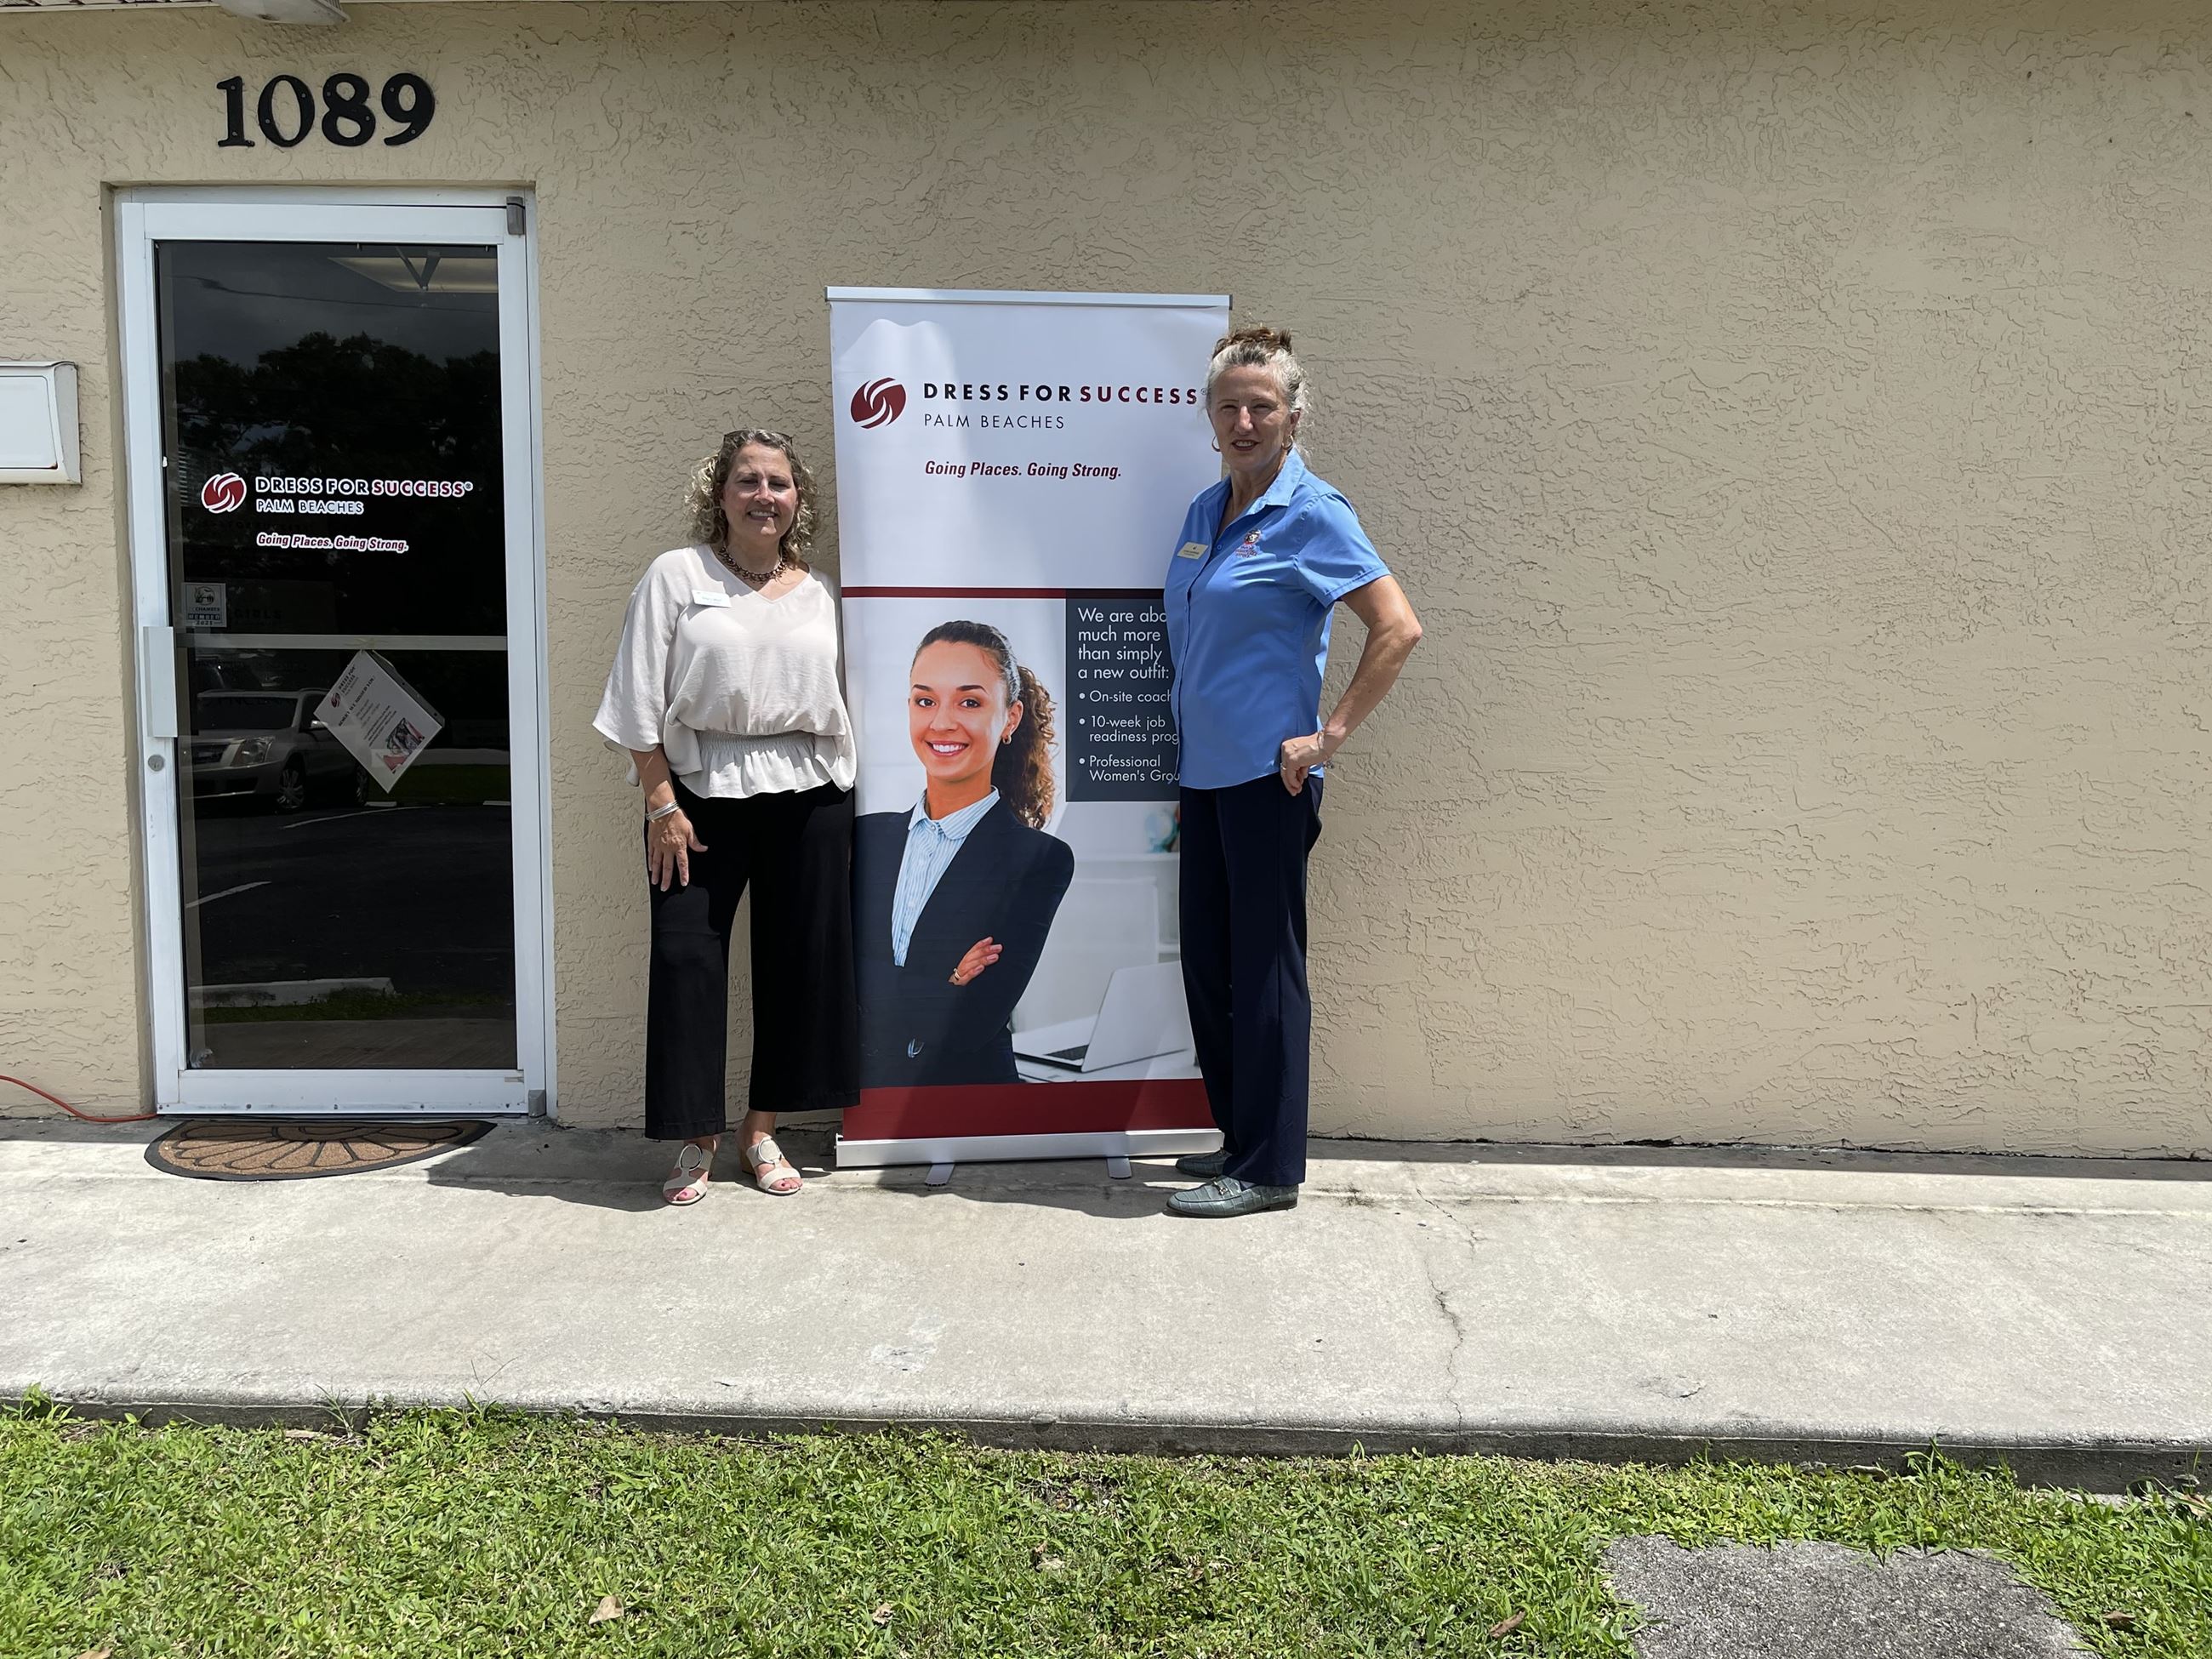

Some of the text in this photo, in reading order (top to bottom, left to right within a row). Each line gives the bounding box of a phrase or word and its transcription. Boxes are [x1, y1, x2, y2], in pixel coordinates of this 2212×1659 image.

[216, 73, 436, 147] 1089
[923, 383, 1010, 401] DRESS
[1020, 385, 1072, 402] FOR
[924, 413, 1065, 429] PALM BEACHES
[925, 460, 1122, 479] Going Places. Going Strong.
[255, 476, 322, 493] DRESS
[326, 477, 369, 495] FOR
[256, 499, 364, 514] PALM BEACHES
[257, 532, 408, 553] Going Places. Going Strong.
[1077, 606, 1167, 623] We are abo
[1077, 624, 1161, 641] much more
[1077, 643, 1163, 665] than simply
[1077, 664, 1170, 679] a new outfit:
[1089, 689, 1172, 702] On-site coach
[1090, 715, 1166, 731] 10-week job
[1089, 729, 1179, 745] readiness prog
[1089, 754, 1160, 767] Professional
[1089, 769, 1180, 782] Women's Grou
